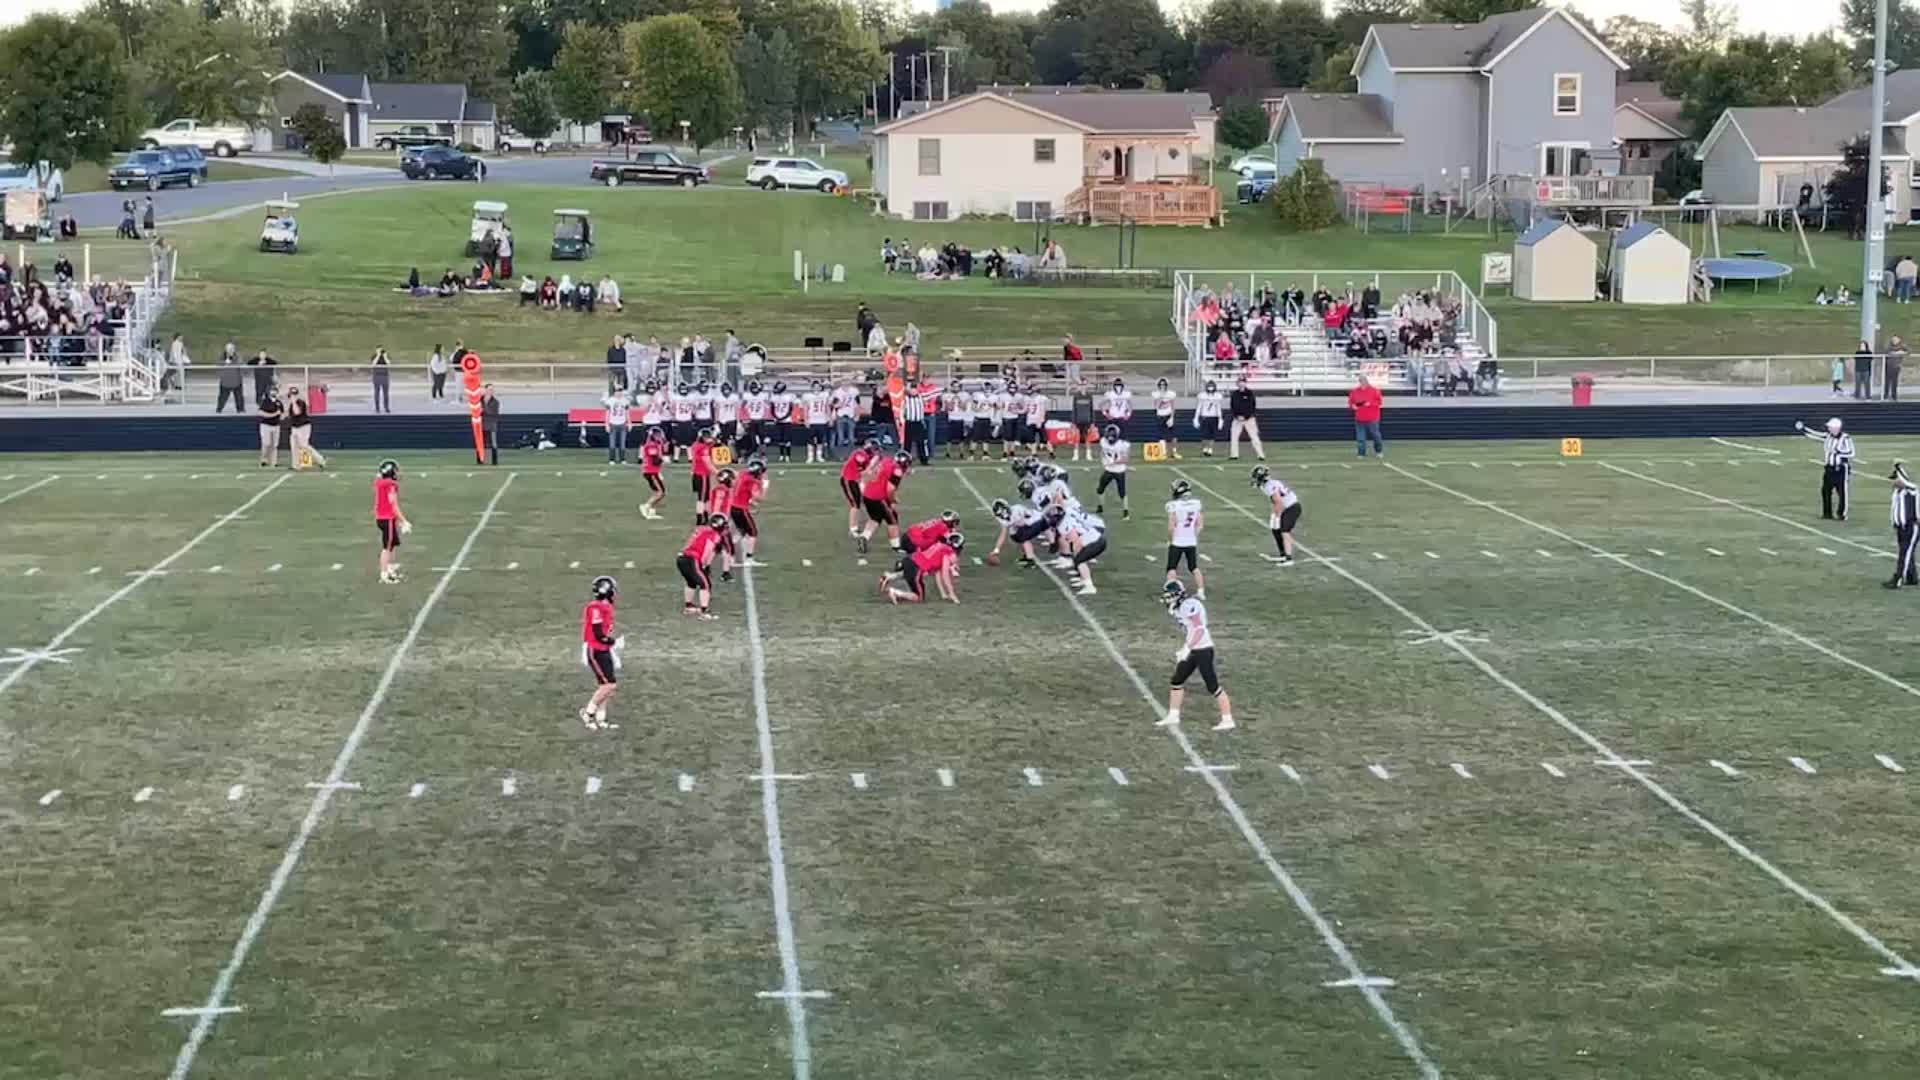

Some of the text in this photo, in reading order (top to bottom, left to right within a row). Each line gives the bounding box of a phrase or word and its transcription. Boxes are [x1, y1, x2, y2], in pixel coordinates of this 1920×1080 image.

[1146, 445, 1160, 458] 40
[1566, 440, 1578, 453] 30
[715, 448, 729, 462] 50
